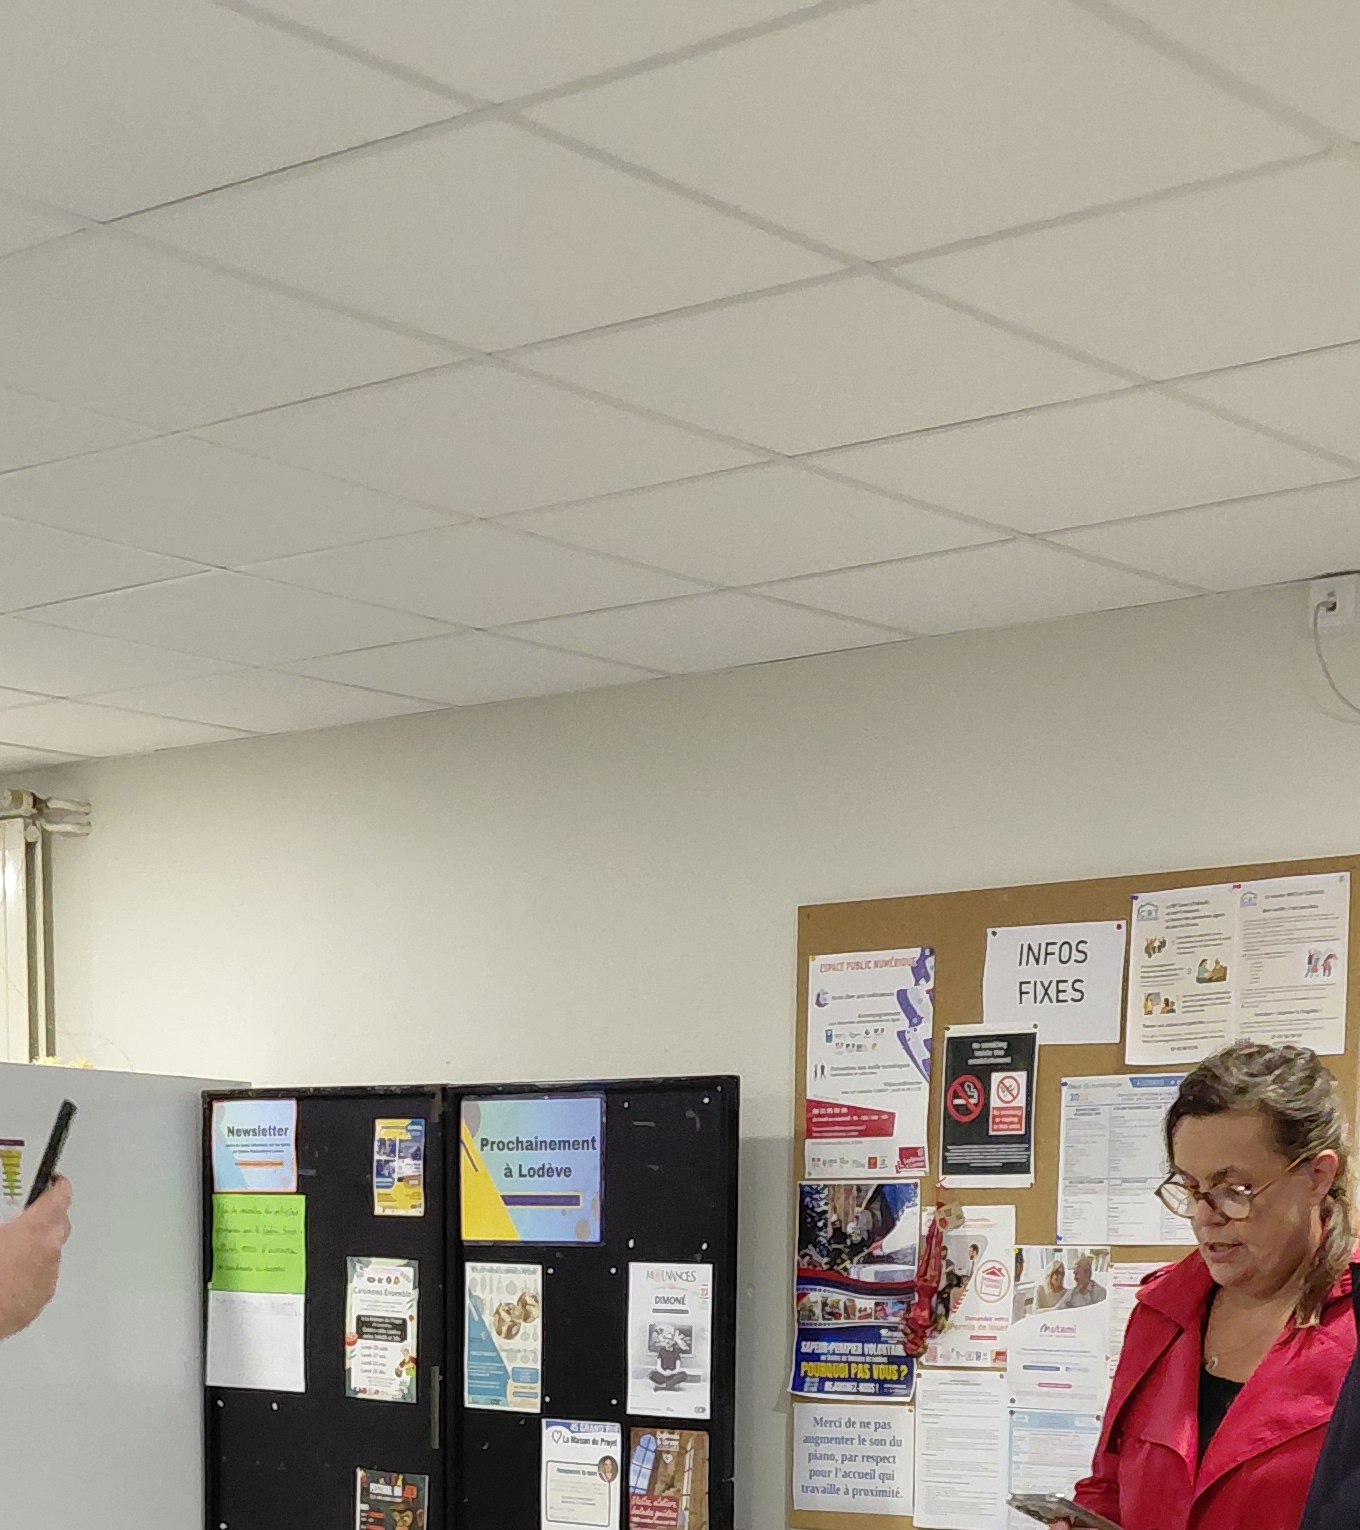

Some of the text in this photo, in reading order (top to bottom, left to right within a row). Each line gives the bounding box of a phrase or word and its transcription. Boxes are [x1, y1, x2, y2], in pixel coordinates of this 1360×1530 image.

[1018, 940, 1088, 966] INFOS
[820, 962, 845, 973] ESPACE
[846, 960, 872, 971] PUBLIC
[1019, 979, 1085, 1004] FIXES
[226, 1125, 289, 1138] Newsletter
[480, 1136, 597, 1151] Prochainement
[503, 1162, 572, 1178] à Lodève
[654, 1294, 687, 1306] DIMONÉ
[800, 1362, 849, 1378] POURQUOI
[851, 1362, 871, 1379] PAS
[872, 1363, 898, 1380] VOUS
[813, 1416, 892, 1432] Merci de ne pas
[802, 1434, 903, 1447] augmenter le son du
[807, 1450, 897, 1466] piano, par respect
[808, 1467, 895, 1483] pour l'accueil qui
[800, 1483, 904, 1500] travaille à proximité.
